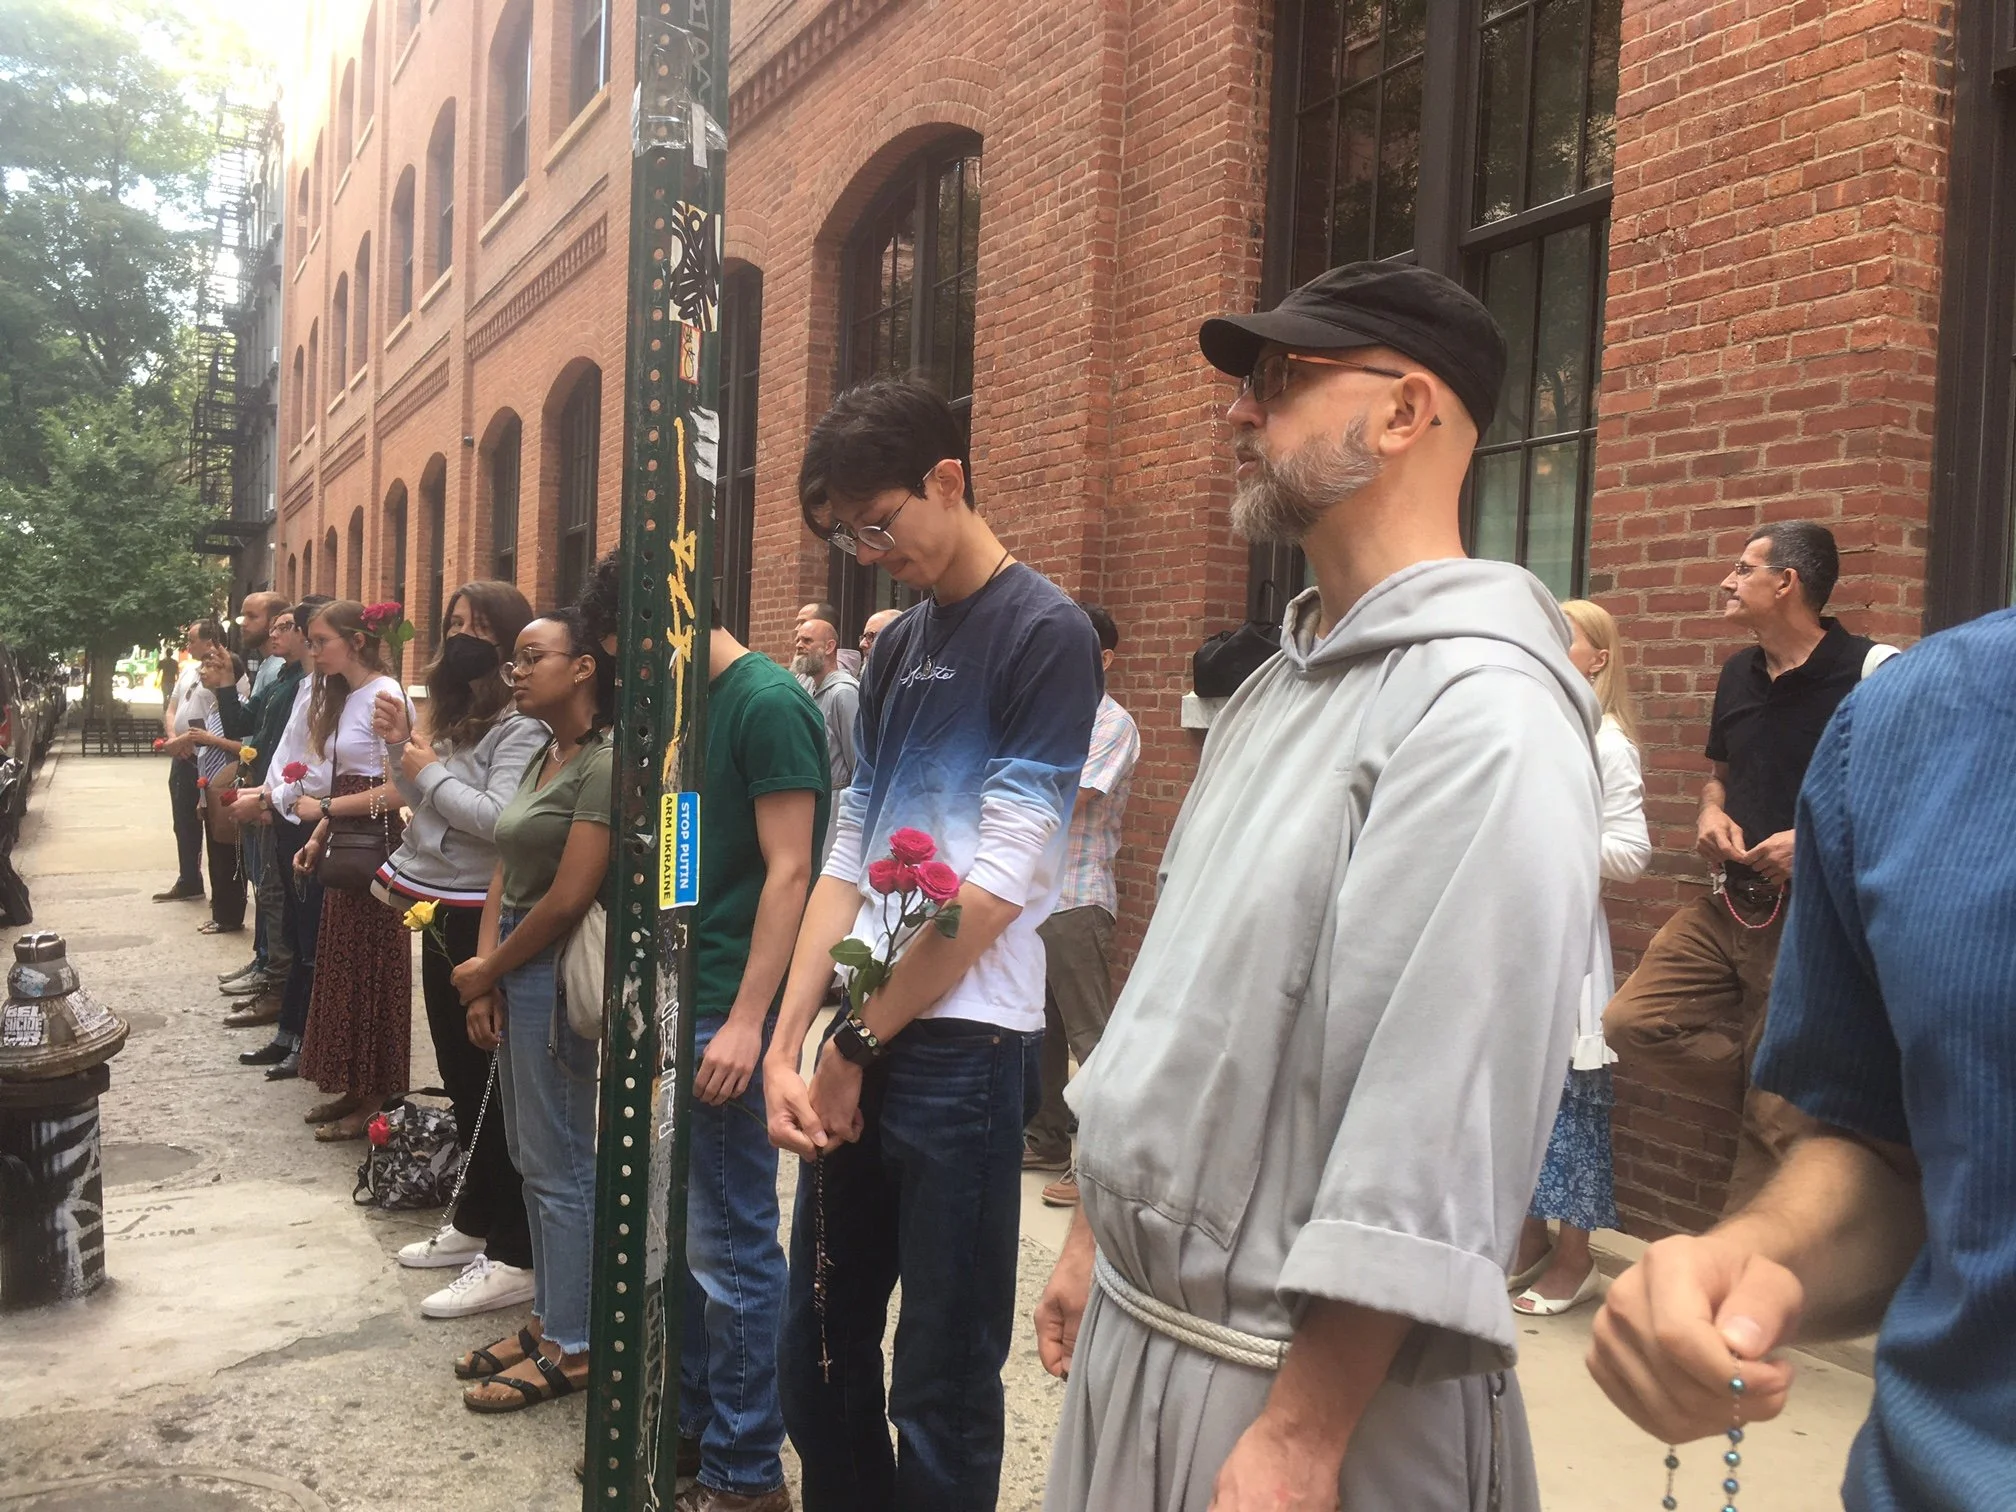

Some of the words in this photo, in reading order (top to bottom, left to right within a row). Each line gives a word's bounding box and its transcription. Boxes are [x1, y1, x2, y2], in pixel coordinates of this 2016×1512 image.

[665, 796, 673, 829] ARM
[680, 802, 690, 840] STOP
[663, 833, 672, 900] UKRAINE
[679, 843, 690, 889] PUTIN
